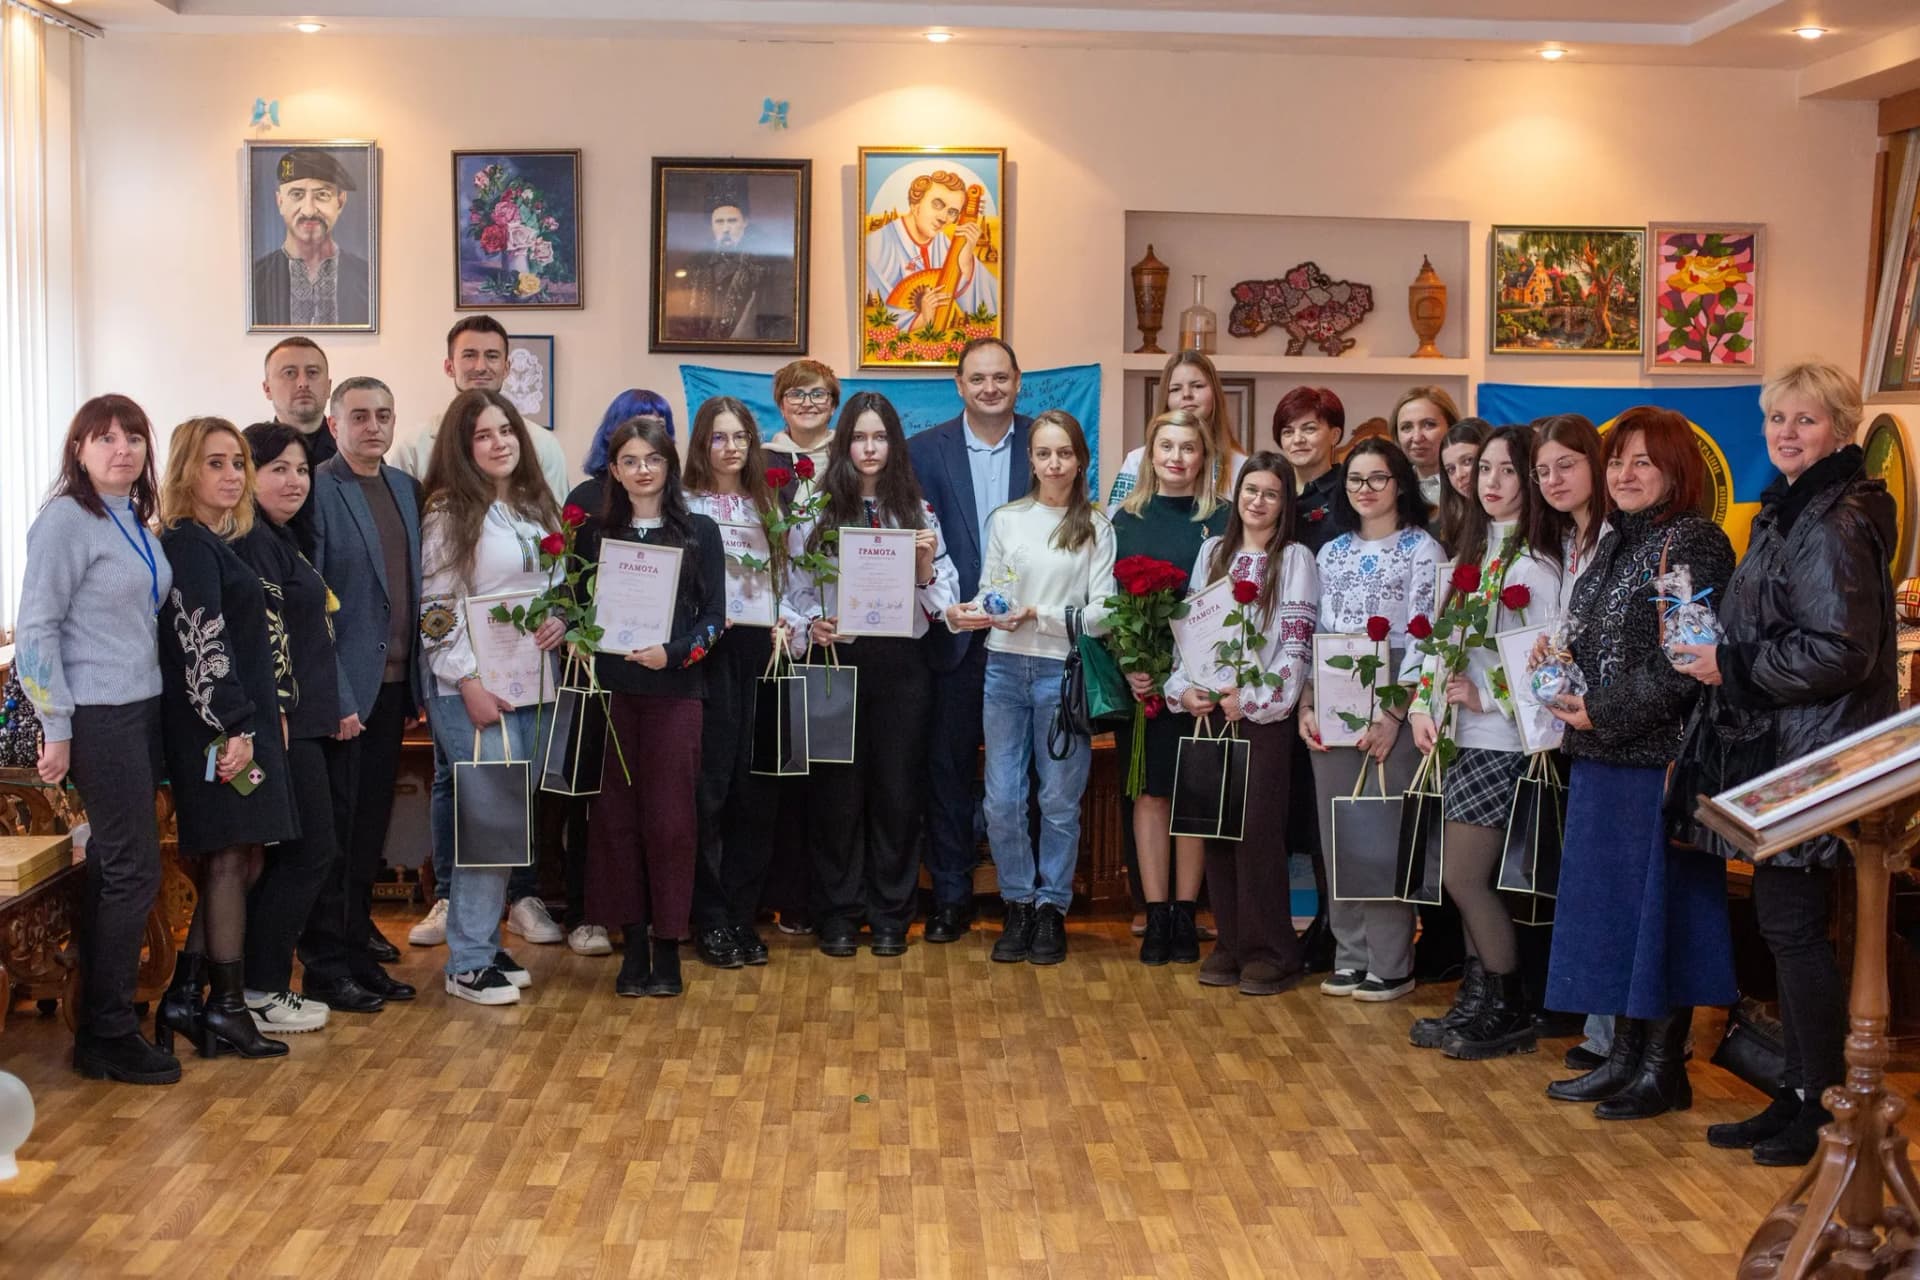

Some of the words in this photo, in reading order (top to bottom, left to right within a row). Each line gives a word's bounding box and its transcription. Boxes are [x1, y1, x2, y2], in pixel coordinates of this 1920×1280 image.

[858, 547, 897, 556] ГРАМОТА
[618, 561, 659, 574] ГРАМОТА
[1188, 603, 1221, 625] ГРАМОТА
